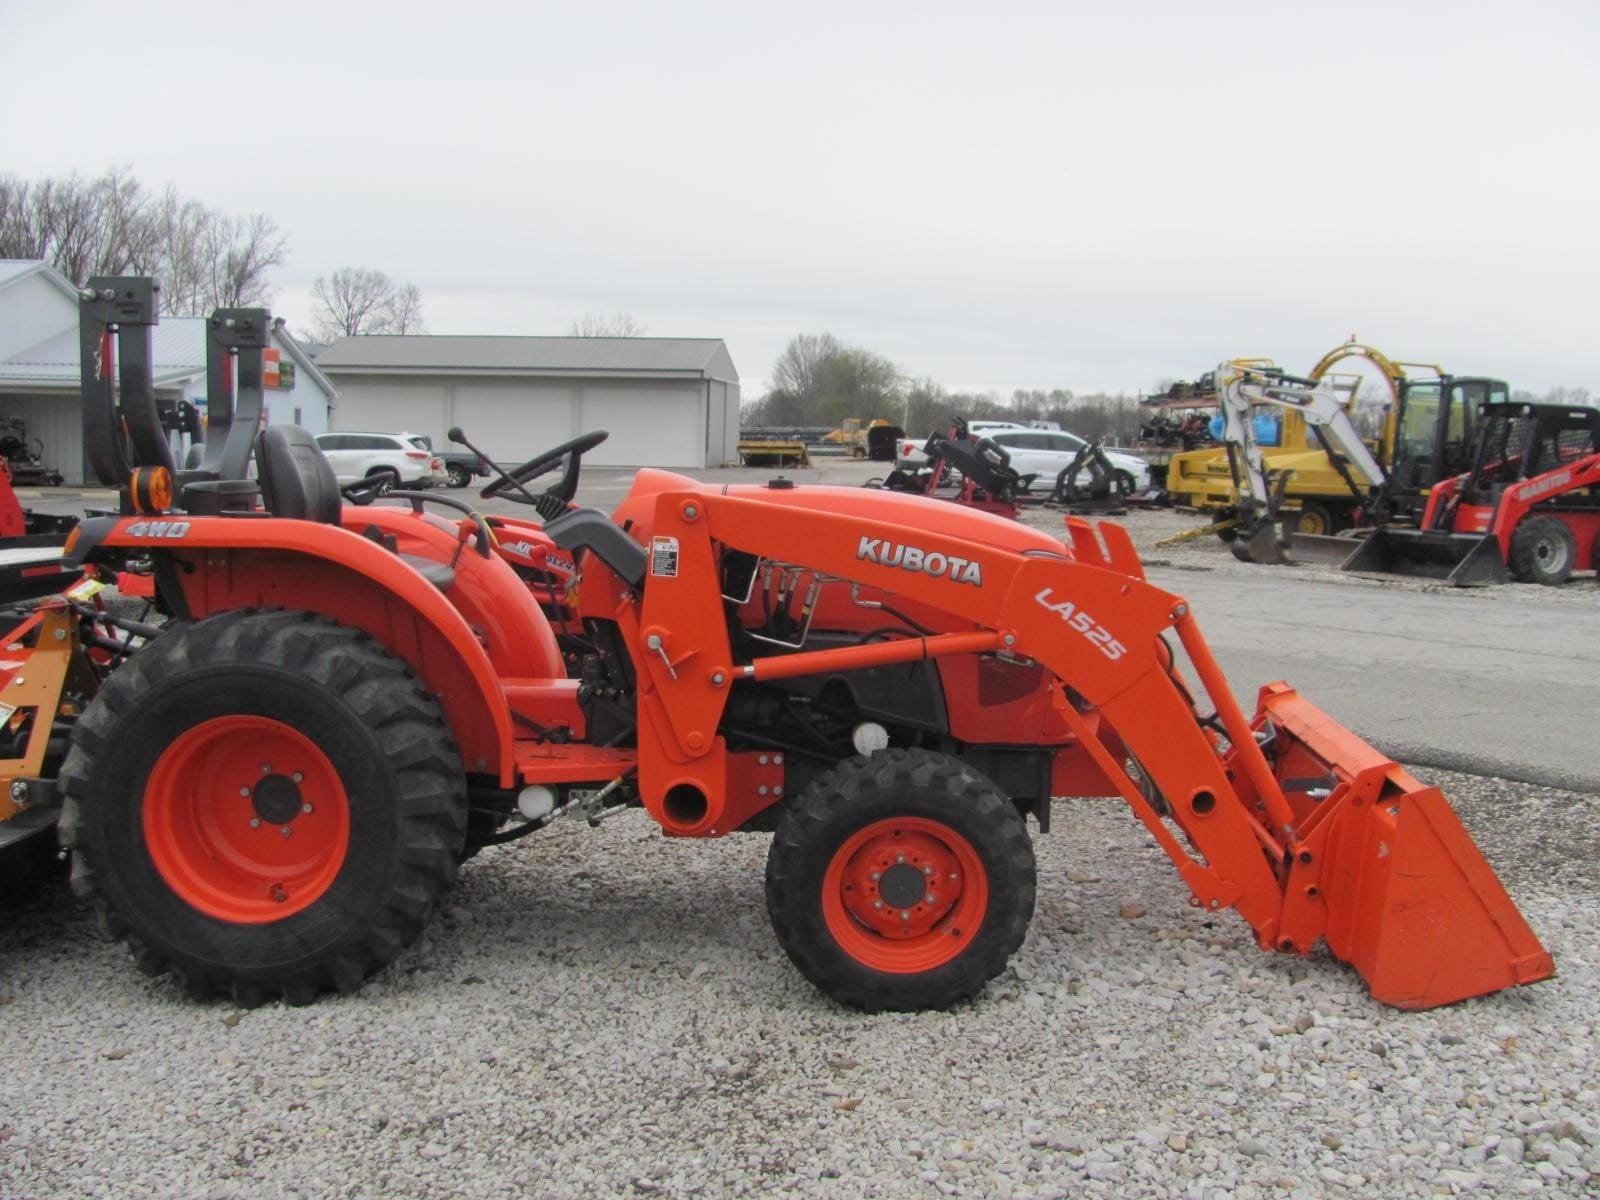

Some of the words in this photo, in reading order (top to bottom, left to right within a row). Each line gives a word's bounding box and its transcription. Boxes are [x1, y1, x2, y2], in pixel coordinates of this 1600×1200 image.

[124, 521, 191, 538] 4WD
[856, 535, 983, 587] KUBOTA
[1034, 587, 1127, 661] LA525
